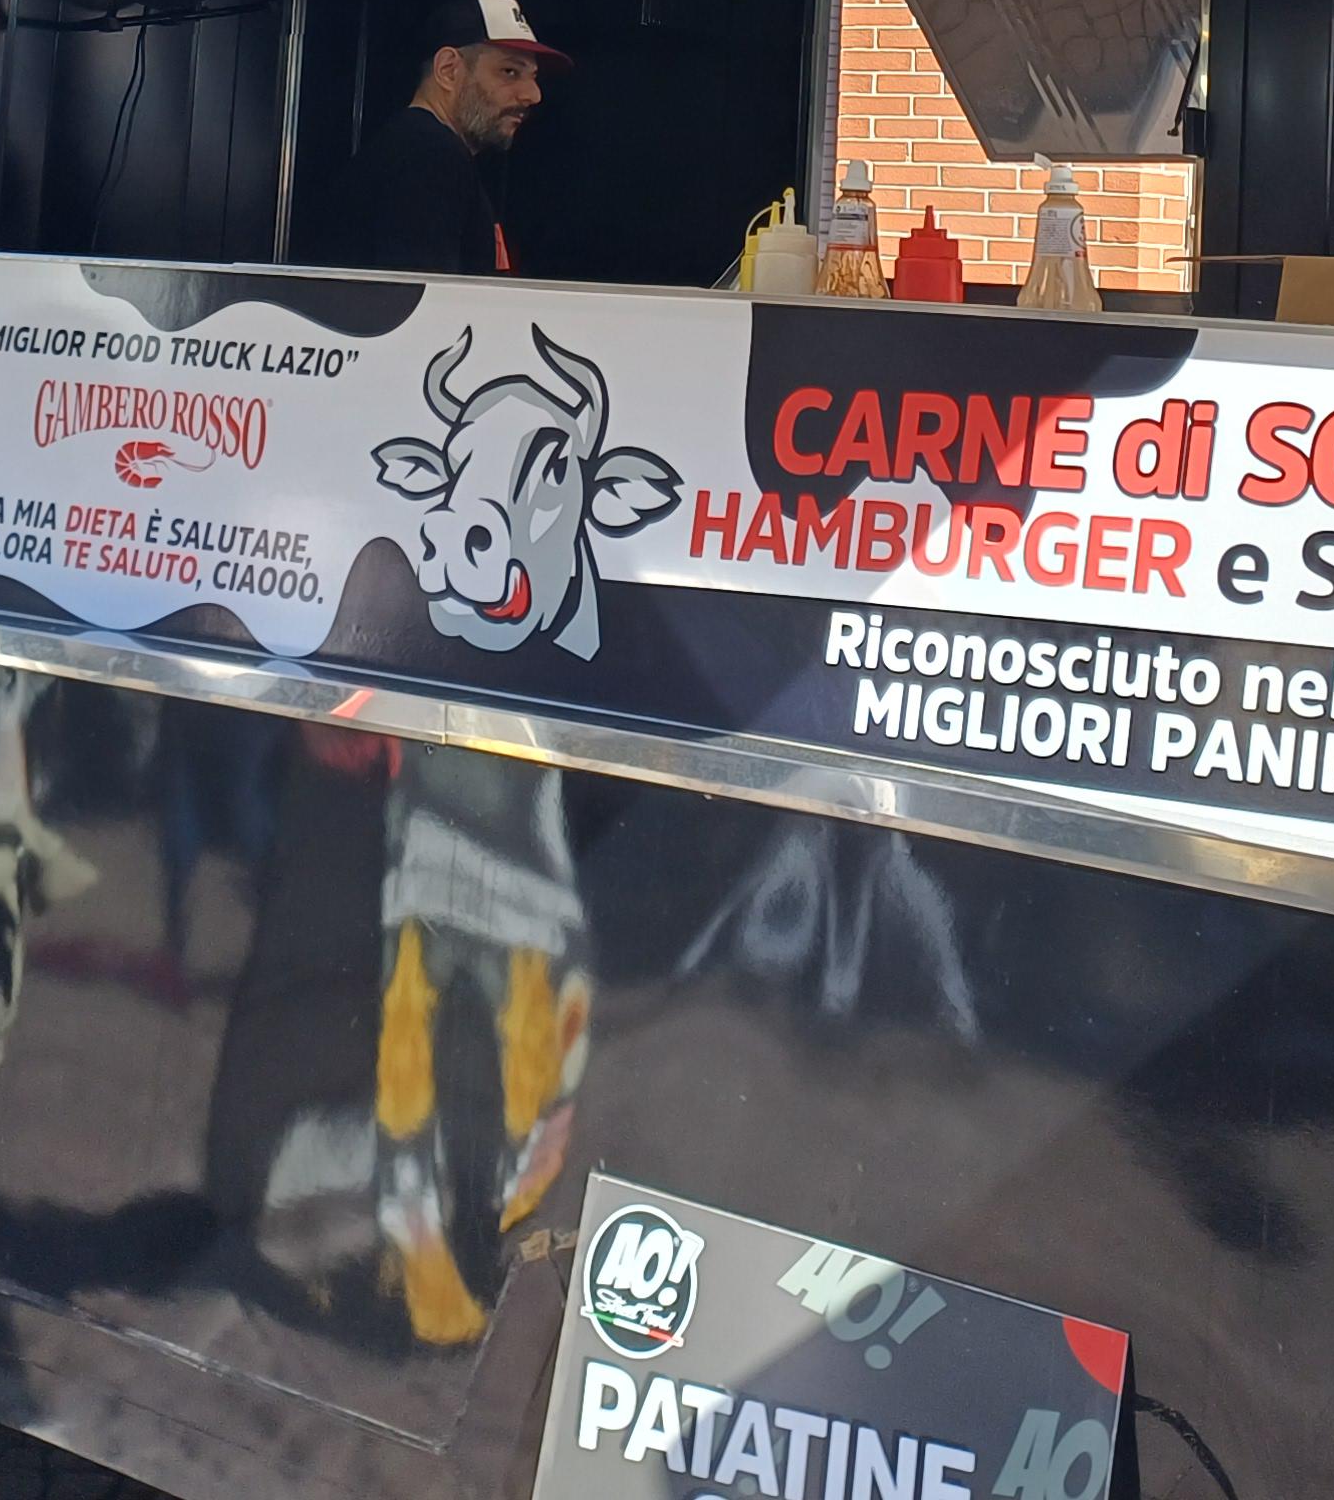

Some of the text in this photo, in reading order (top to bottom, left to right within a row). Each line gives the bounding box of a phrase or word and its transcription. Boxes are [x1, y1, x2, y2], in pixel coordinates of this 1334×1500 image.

[92, 330, 161, 363] FOOD
[170, 337, 256, 372] TRUCK
[34, 379, 267, 470] GAMBERO ROSSO
[774, 387, 1094, 490] CARNE
[1114, 399, 1218, 501] di
[13, 499, 56, 530] MIA
[66, 505, 136, 540] DIETA
[145, 508, 161, 543] È
[167, 518, 312, 570] SALUTARE,
[63, 540, 92, 569] TE
[99, 547, 203, 592] SALUTO,
[212, 560, 324, 604] CIAOOO.
[688, 489, 1194, 598] HAMBURGER
[1216, 541, 1269, 605] e
[825, 611, 1220, 705] Riconosciuto
[853, 678, 1131, 769] MIGLIORI
[596, 1223, 699, 1306] AO!
[578, 1361, 975, 1500] PATATINE
